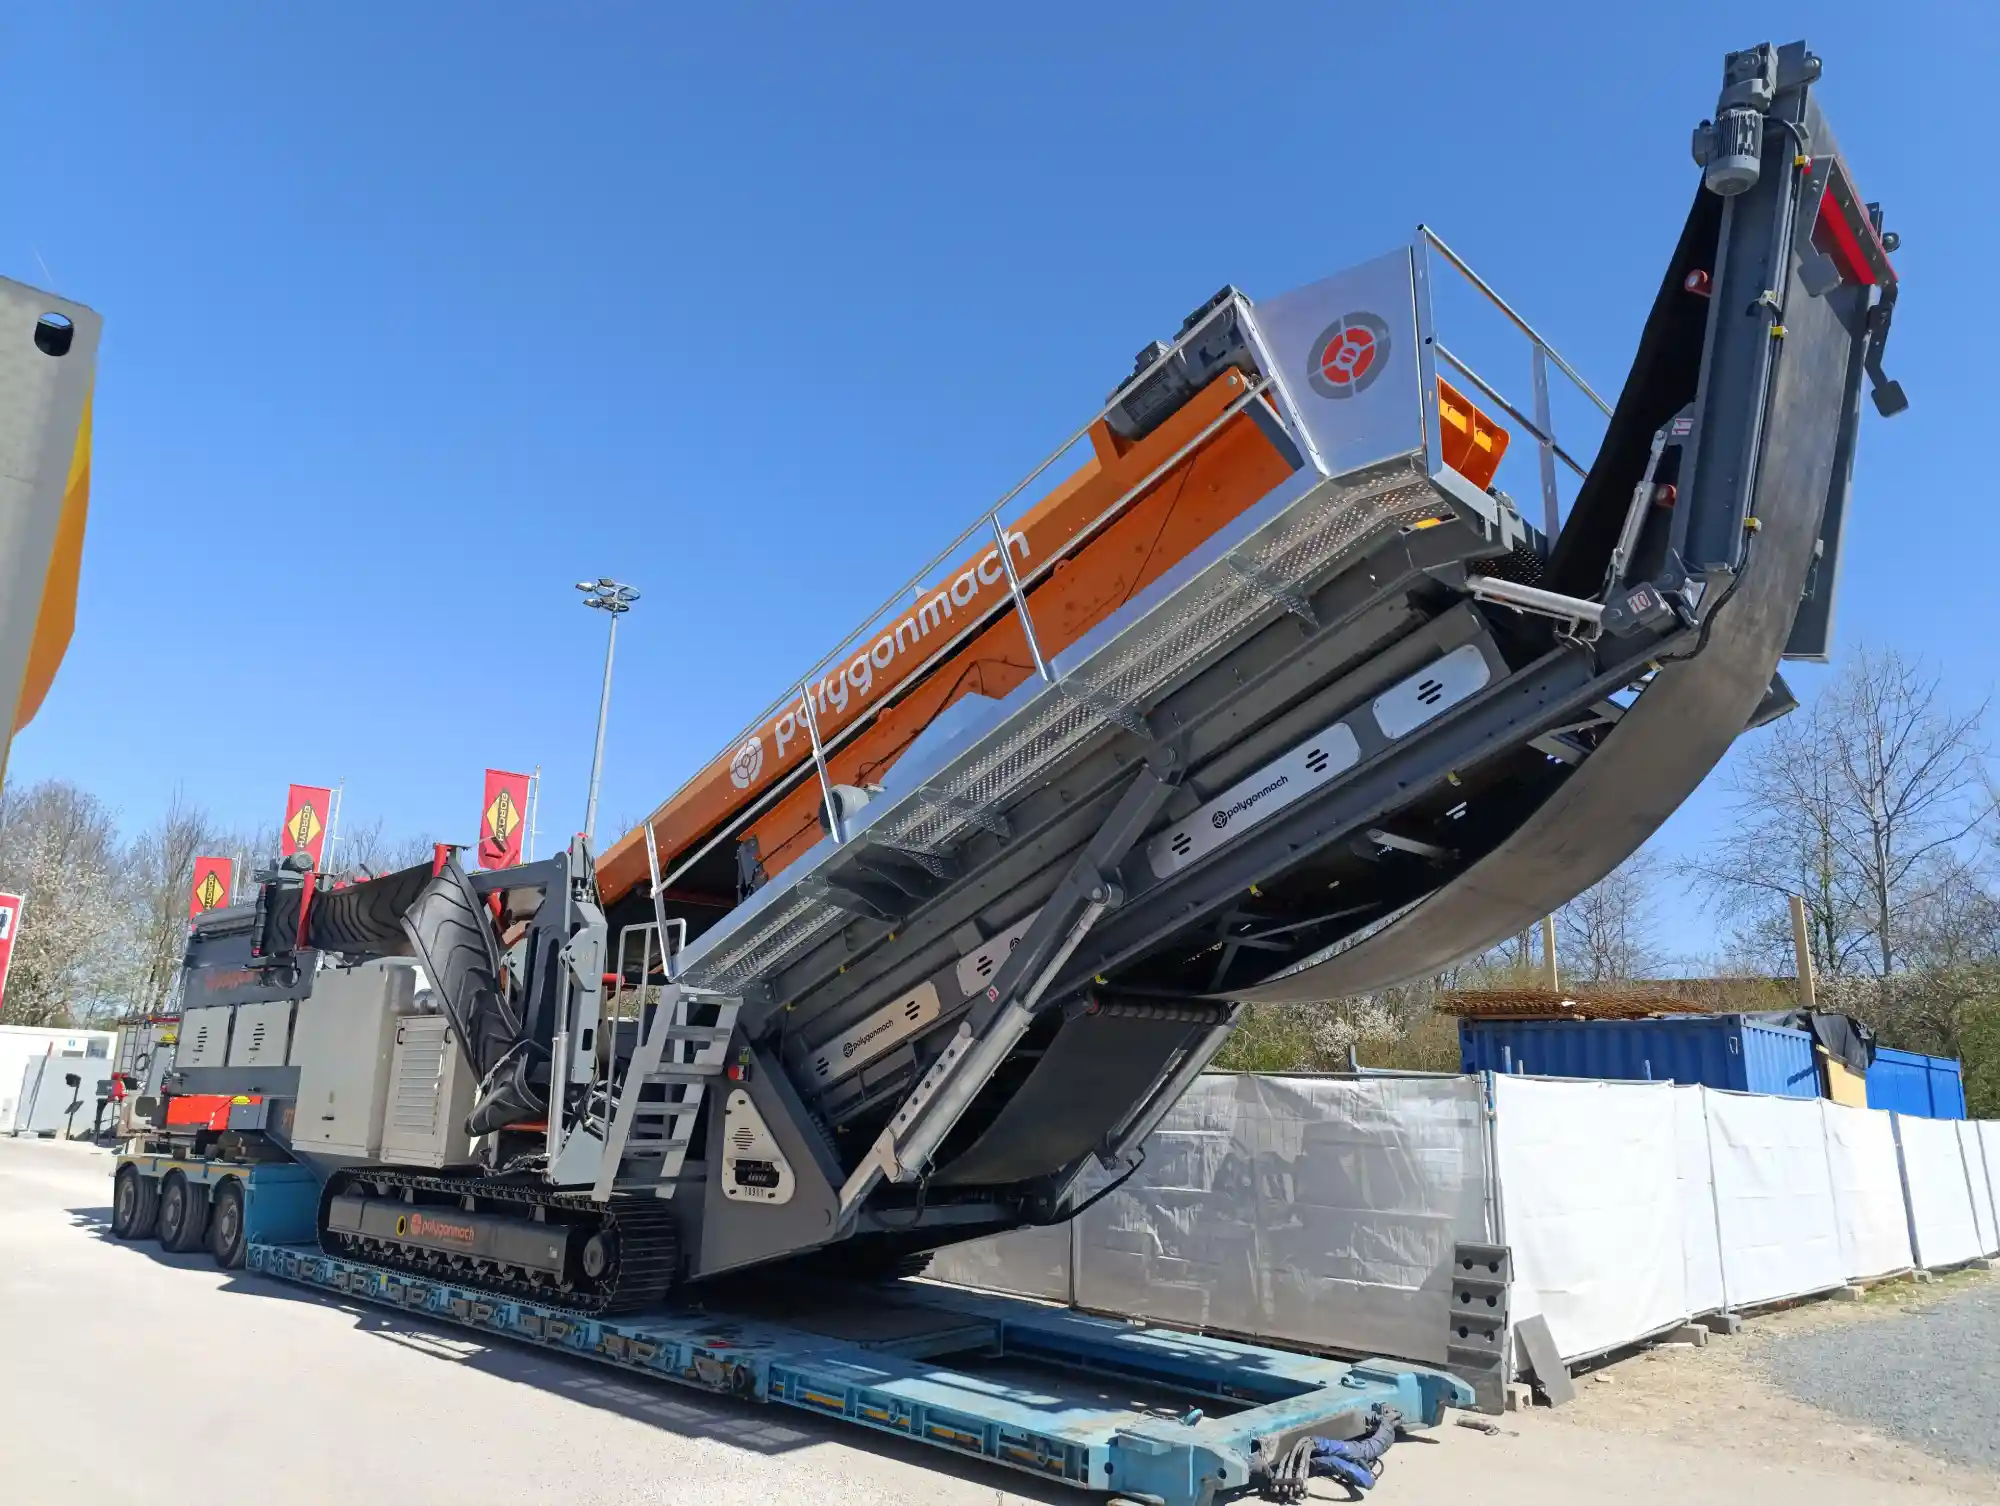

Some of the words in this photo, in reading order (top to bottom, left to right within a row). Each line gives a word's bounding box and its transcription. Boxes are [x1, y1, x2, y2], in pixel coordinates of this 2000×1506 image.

[1631, 593, 1649, 610] 10
[774, 529, 1030, 757] polygonmach
[1226, 775, 1289, 819] polygonmach
[853, 1020, 893, 1050] polygonmach
[421, 1219, 475, 1241] polygonmach
